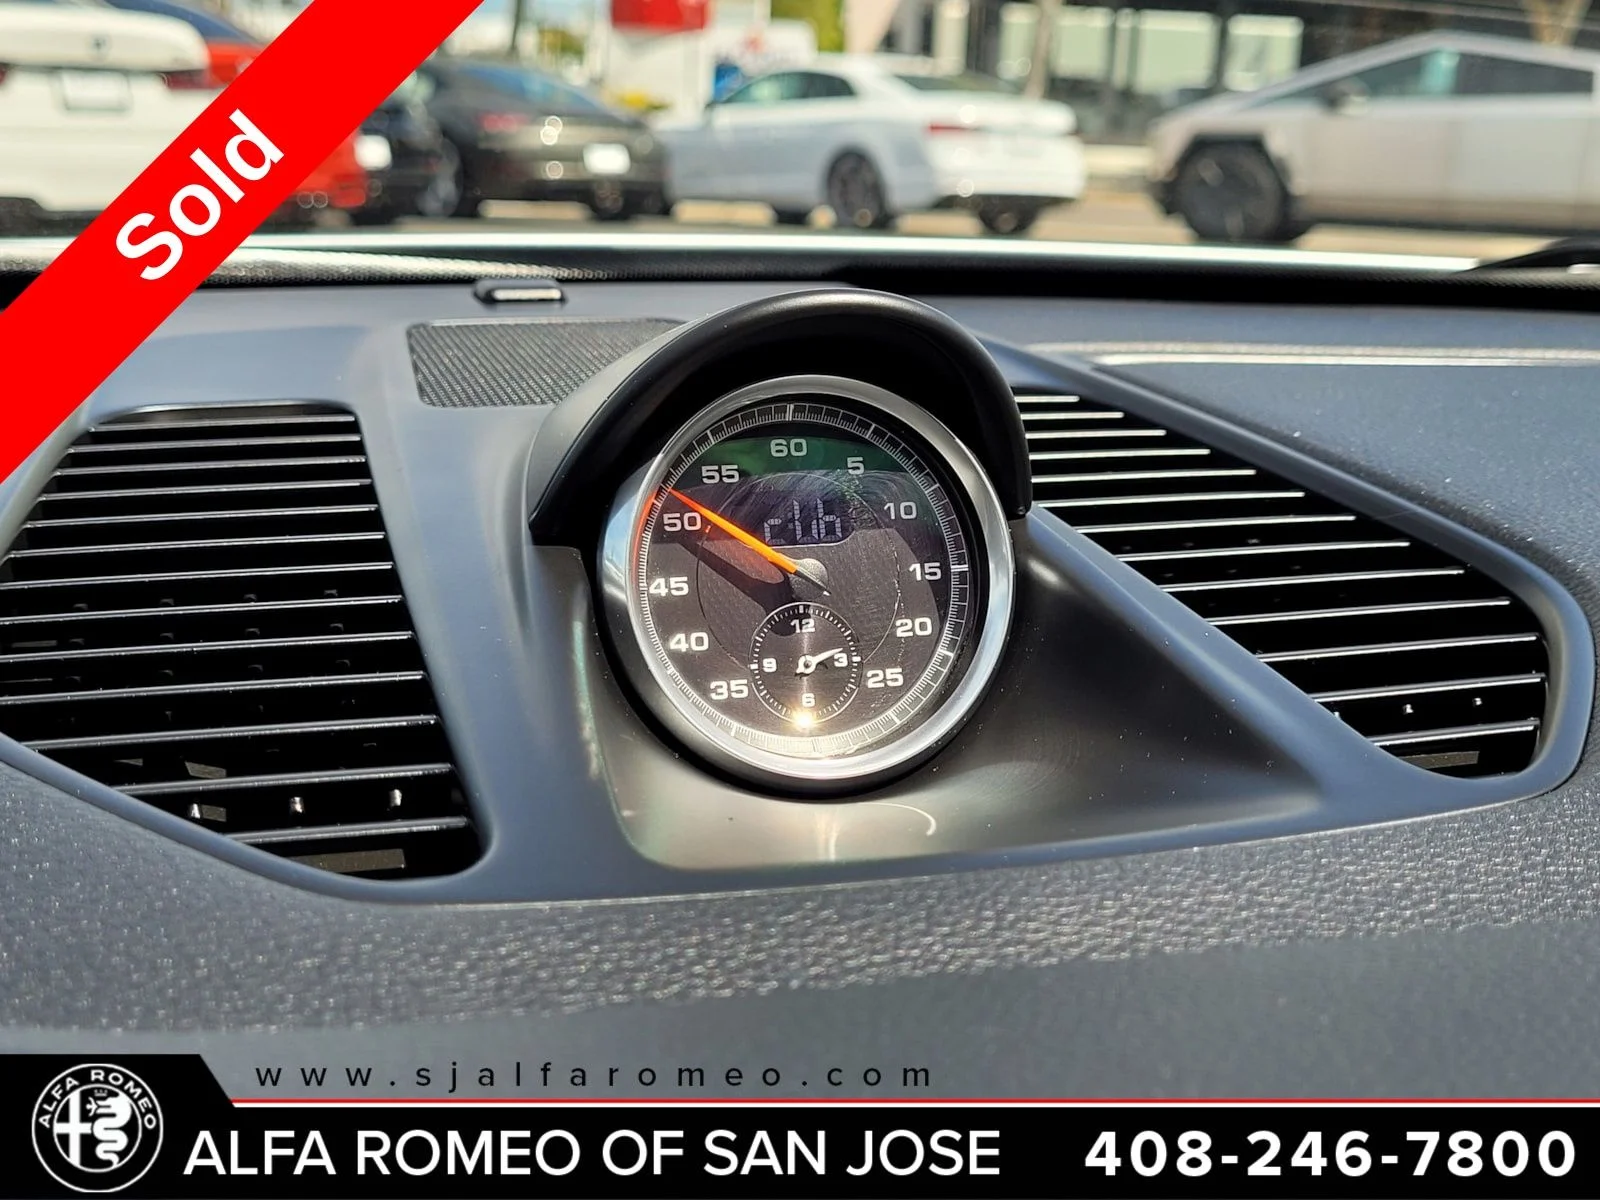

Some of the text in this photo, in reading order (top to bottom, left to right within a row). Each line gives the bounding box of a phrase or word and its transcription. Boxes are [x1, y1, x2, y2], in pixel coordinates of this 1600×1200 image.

[769, 438, 808, 457] 60
[701, 465, 740, 484] 55
[846, 457, 865, 476] 5
[883, 501, 917, 520] 10
[663, 511, 702, 533] 50
[908, 562, 941, 581] 15
[649, 576, 689, 597] 45
[790, 618, 816, 633] 12
[895, 616, 932, 637] 20
[669, 631, 709, 652] 40
[762, 657, 777, 673] 9
[833, 653, 848, 668] 3
[866, 668, 904, 688] 25
[710, 679, 749, 700] 35
[801, 692, 816, 708] 6
